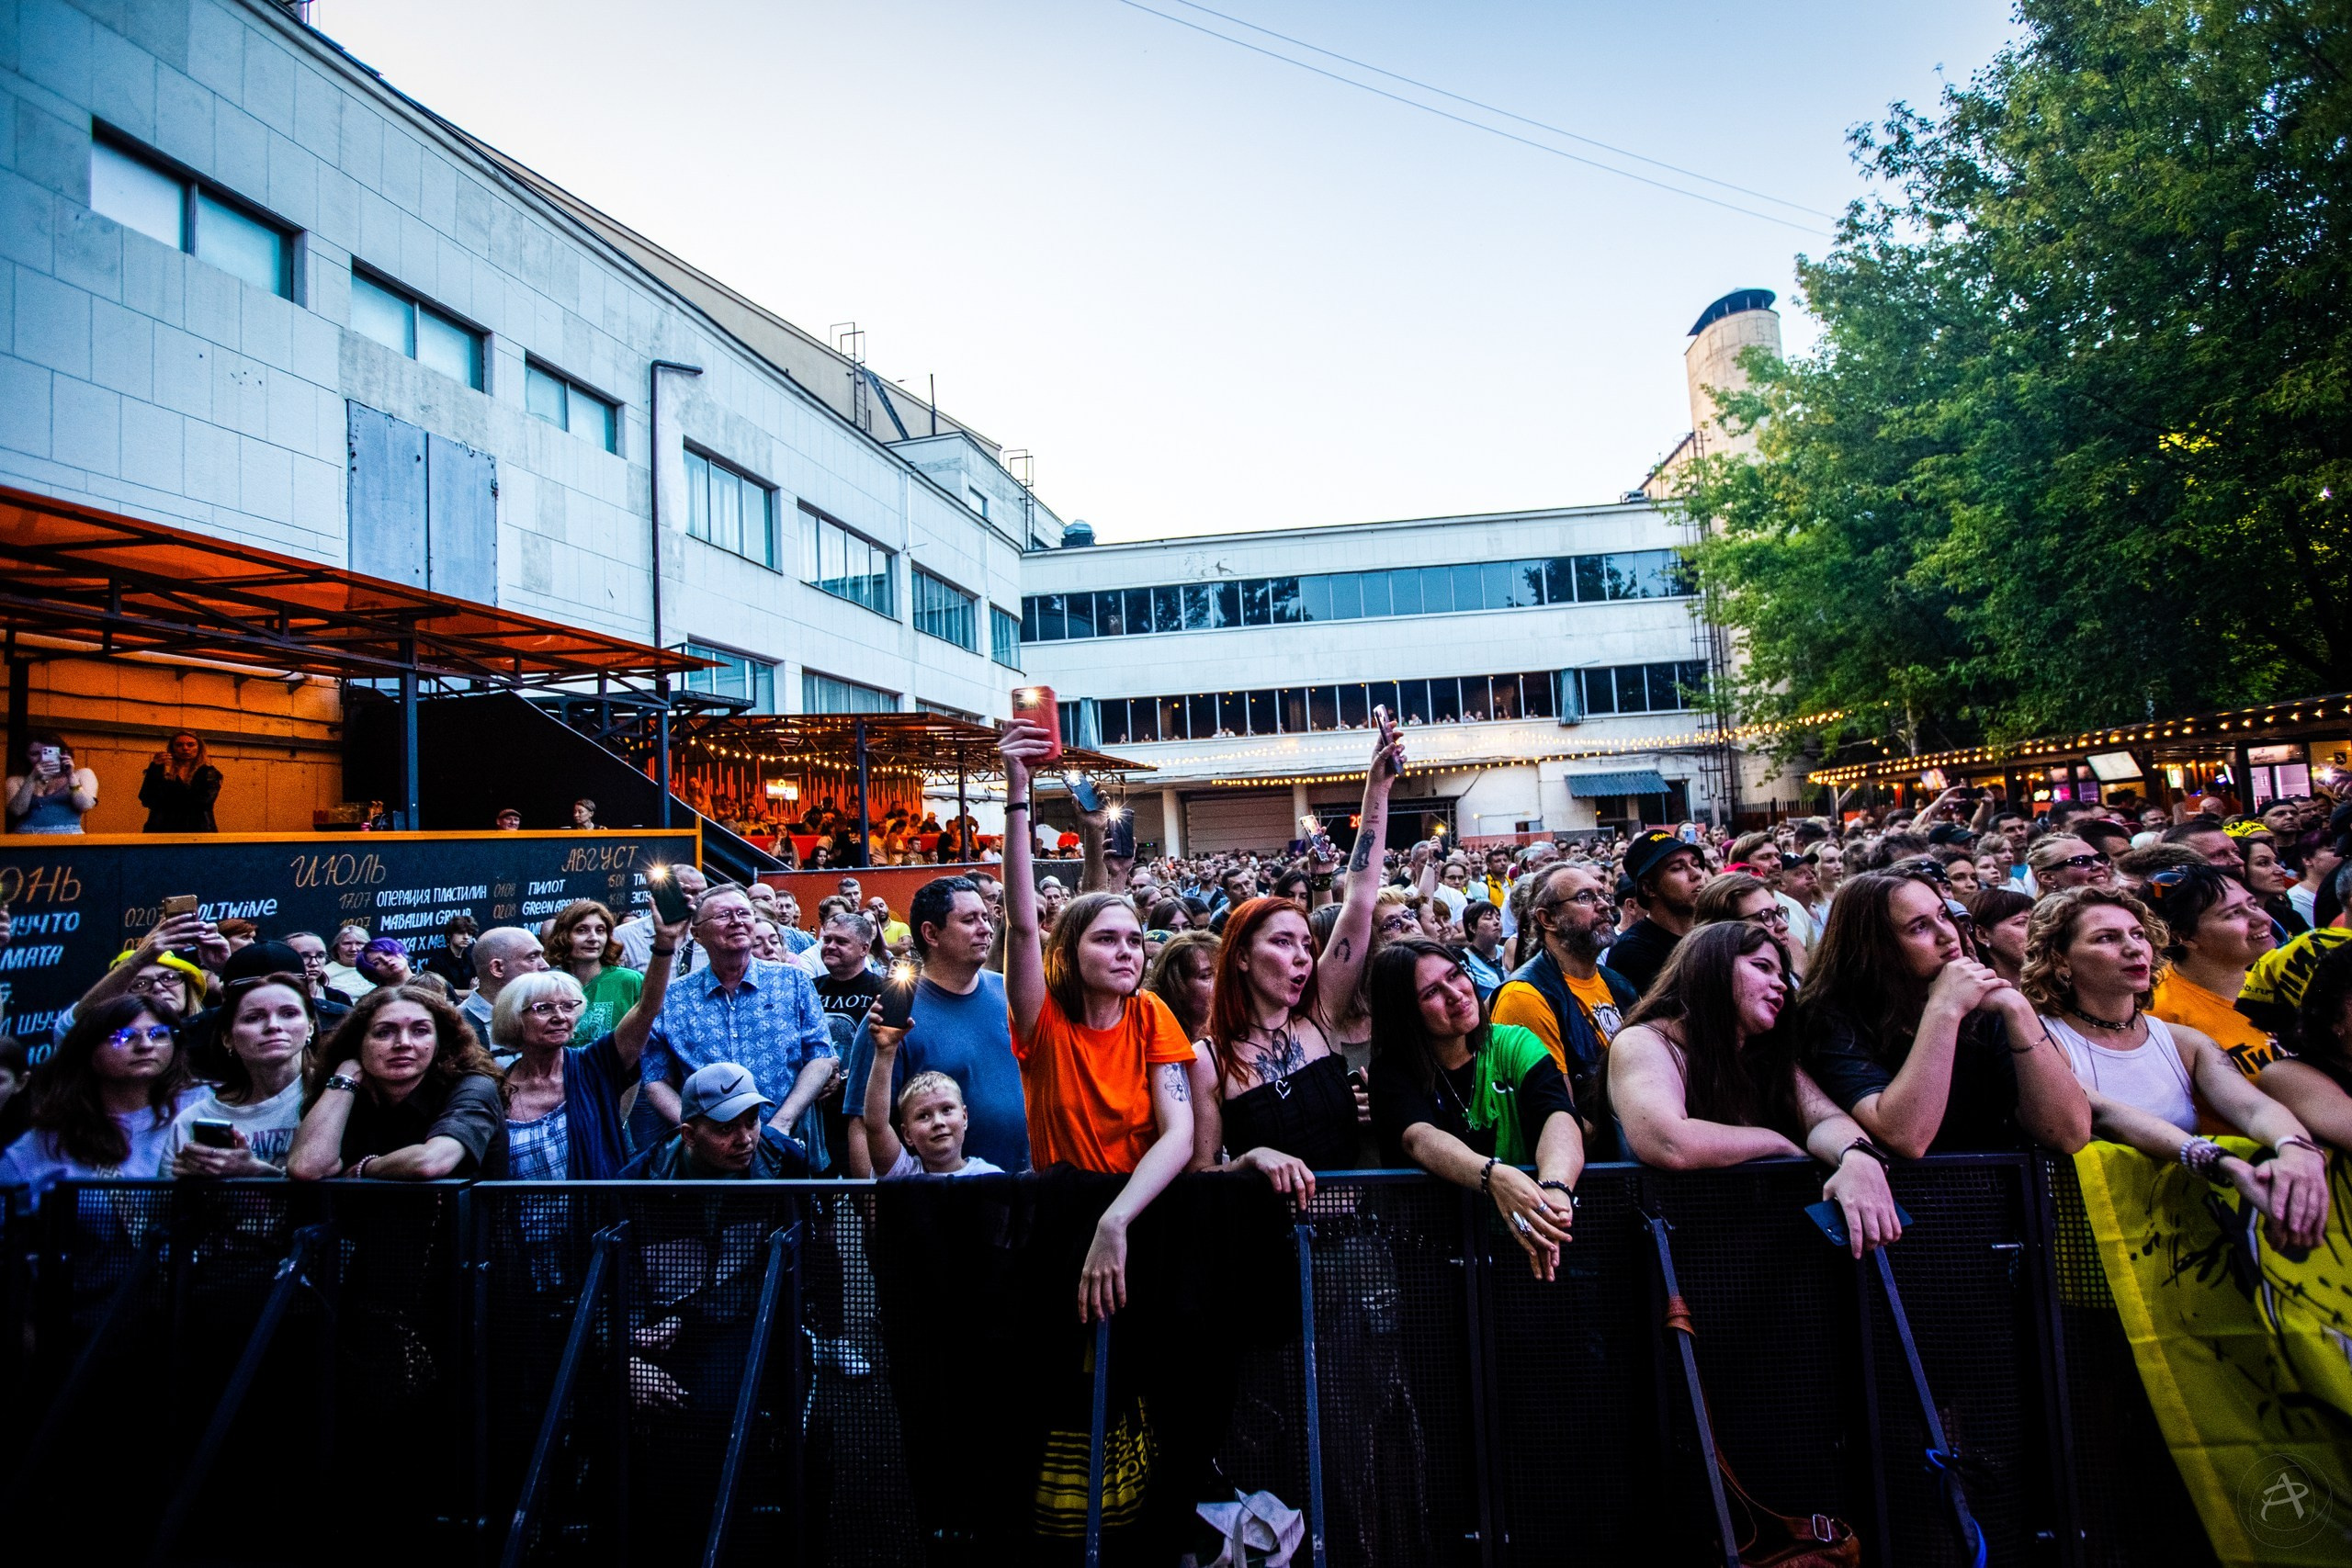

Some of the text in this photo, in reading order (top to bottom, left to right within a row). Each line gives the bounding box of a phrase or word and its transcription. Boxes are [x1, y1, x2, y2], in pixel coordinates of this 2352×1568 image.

[561, 845, 639, 873] АВГУСТ
[290, 853, 387, 888] ИЮЛЬ
[433, 885, 488, 903] ПЛАСТИЛИН
[527, 879, 566, 897] ПИЛОТ
[379, 911, 435, 932] МАВАШИ
